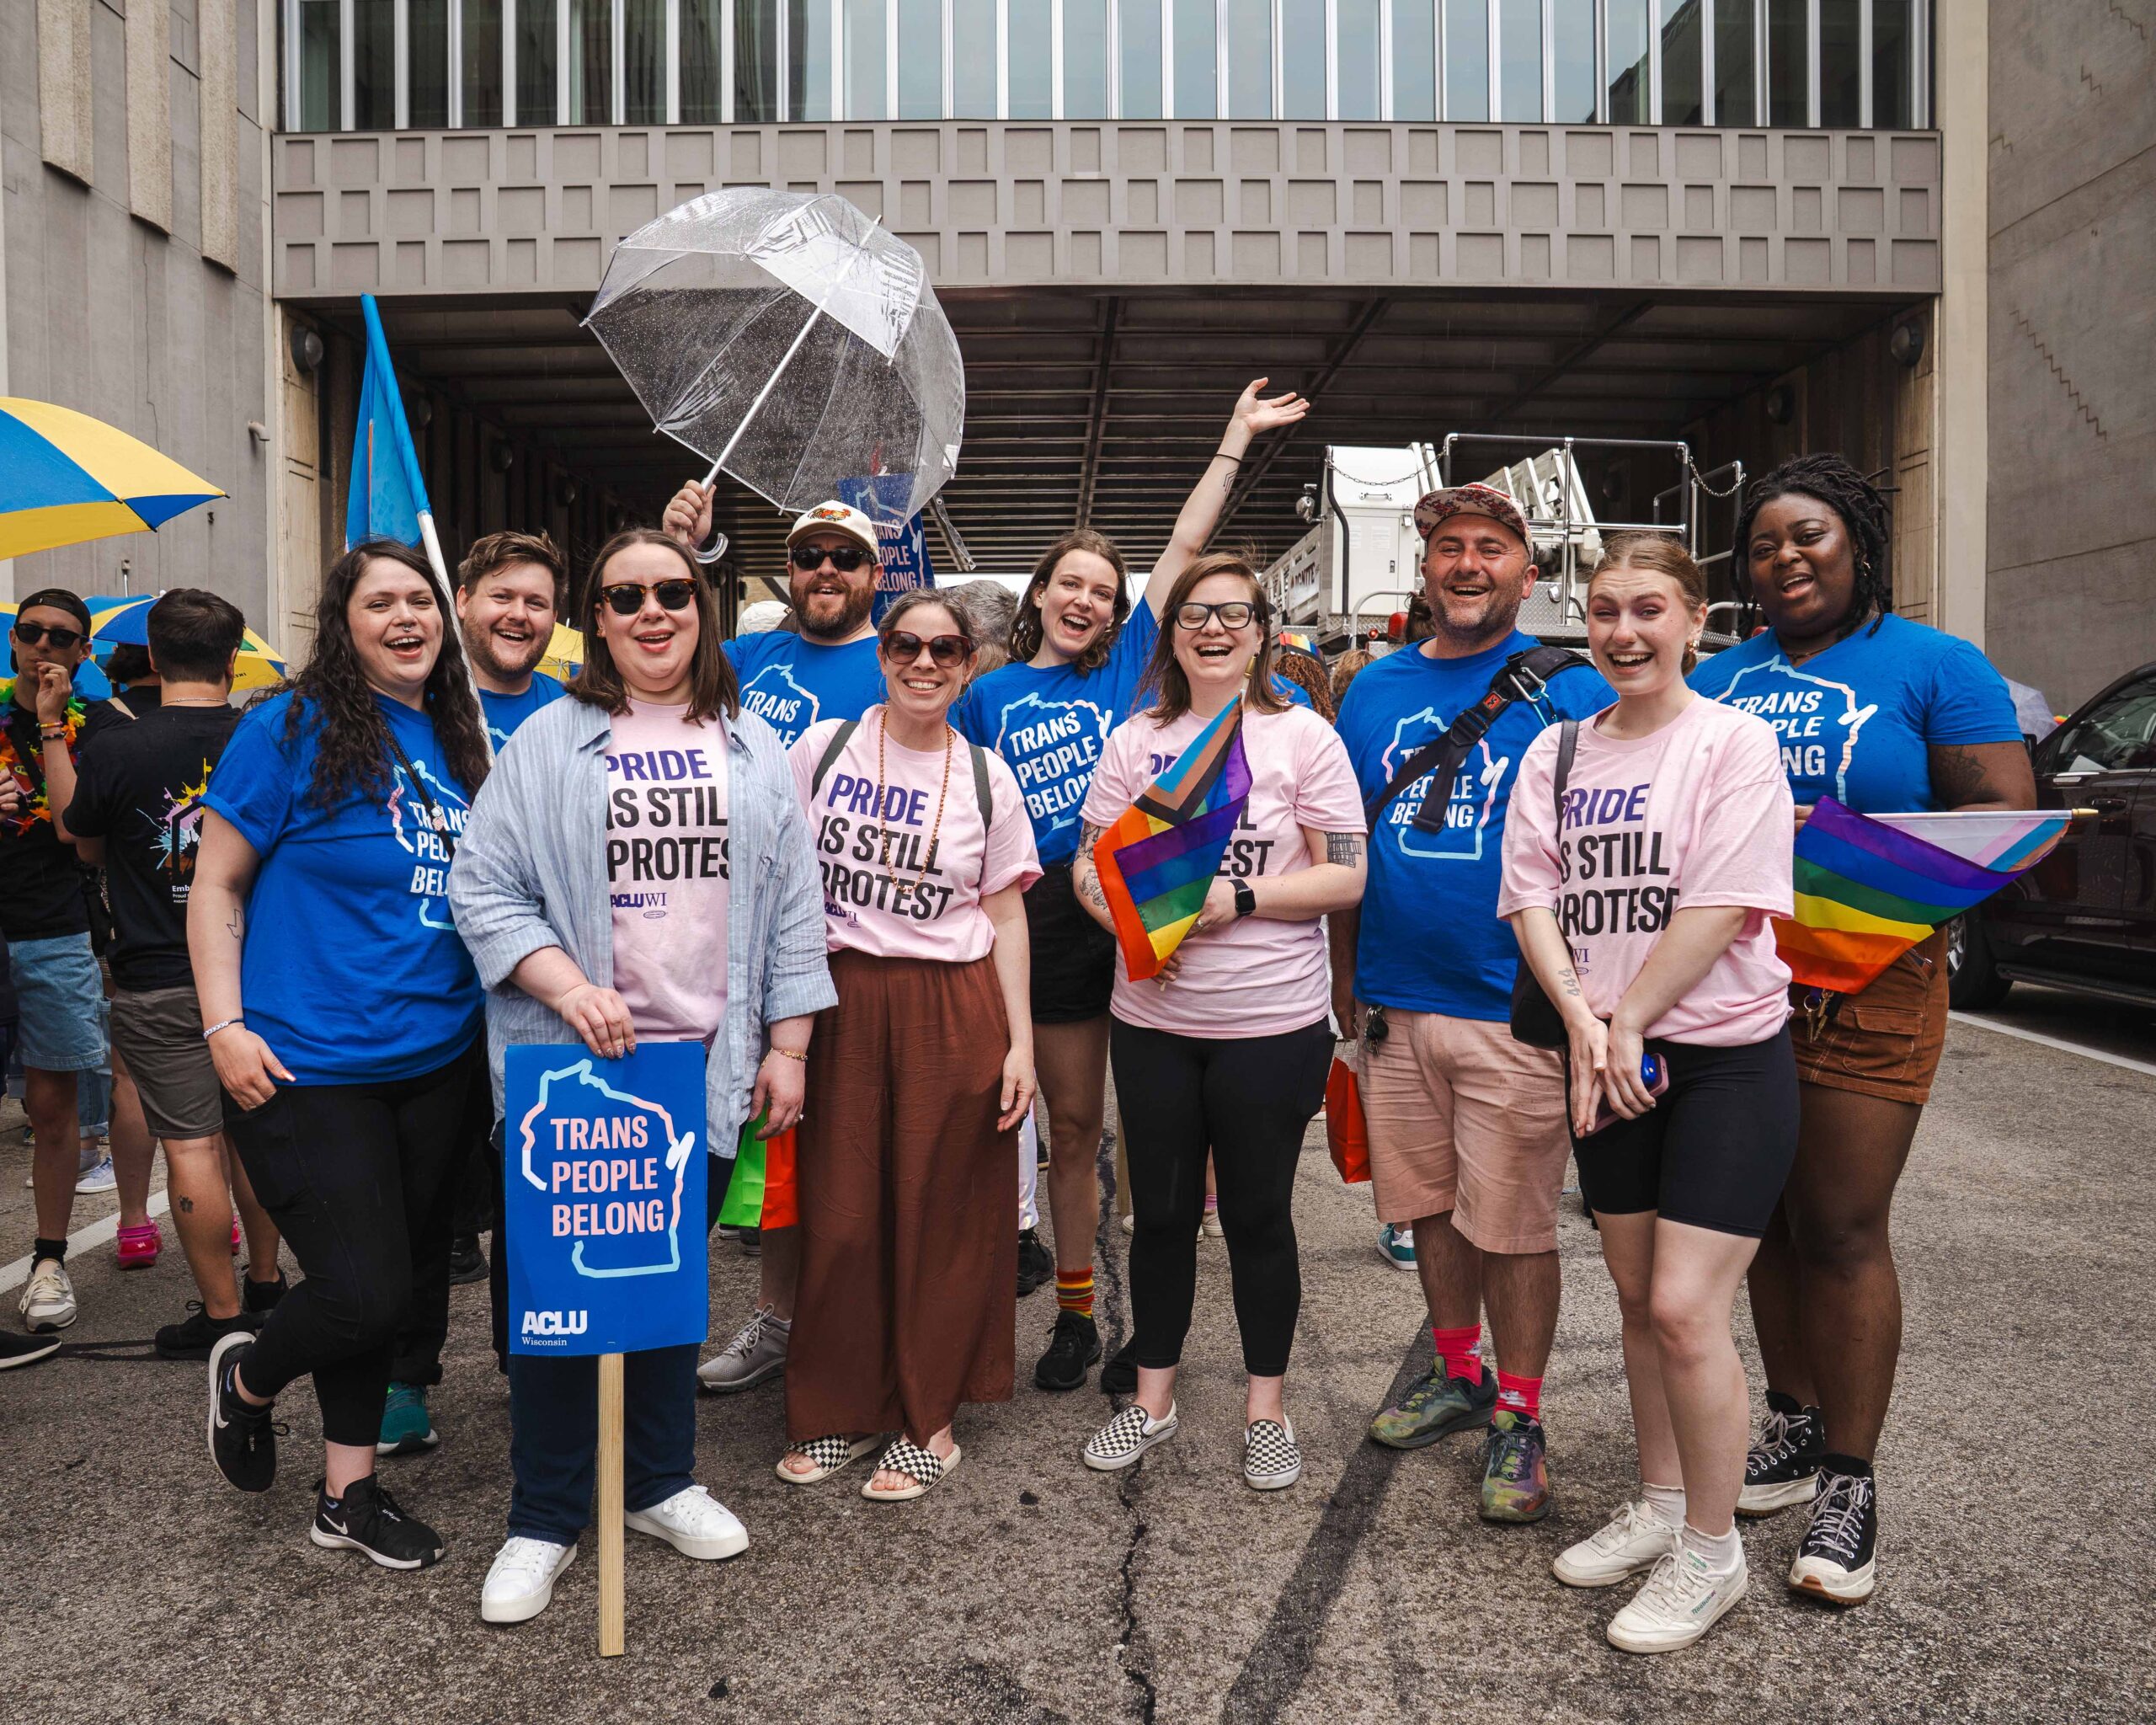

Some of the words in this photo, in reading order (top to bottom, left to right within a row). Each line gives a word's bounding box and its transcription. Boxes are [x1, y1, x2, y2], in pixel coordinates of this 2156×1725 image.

[744, 691, 801, 723] TRANS
[1732, 692, 1823, 714] TRANS
[1009, 711, 1081, 756] TRANS
[606, 750, 712, 781] PRIDE
[1017, 735, 1098, 789] PEOPLE
[827, 773, 929, 826] PRIDE
[1026, 771, 1097, 820] BELON
[1561, 783, 1651, 830] PRIDE
[817, 814, 851, 855] IS
[852, 824, 943, 876] STILL
[1577, 831, 1670, 880] STILL
[819, 860, 954, 921] PROTEST
[550, 1115, 648, 1150] TRANS
[552, 1157, 659, 1194] PEOPLE
[552, 1199, 664, 1236] BELONG
[521, 1311, 588, 1335] ACLU
[522, 1336, 567, 1346] Wisconsin
[1687, 1551, 1707, 1568] Reebok
[1691, 1594, 1712, 1615] Reebok
